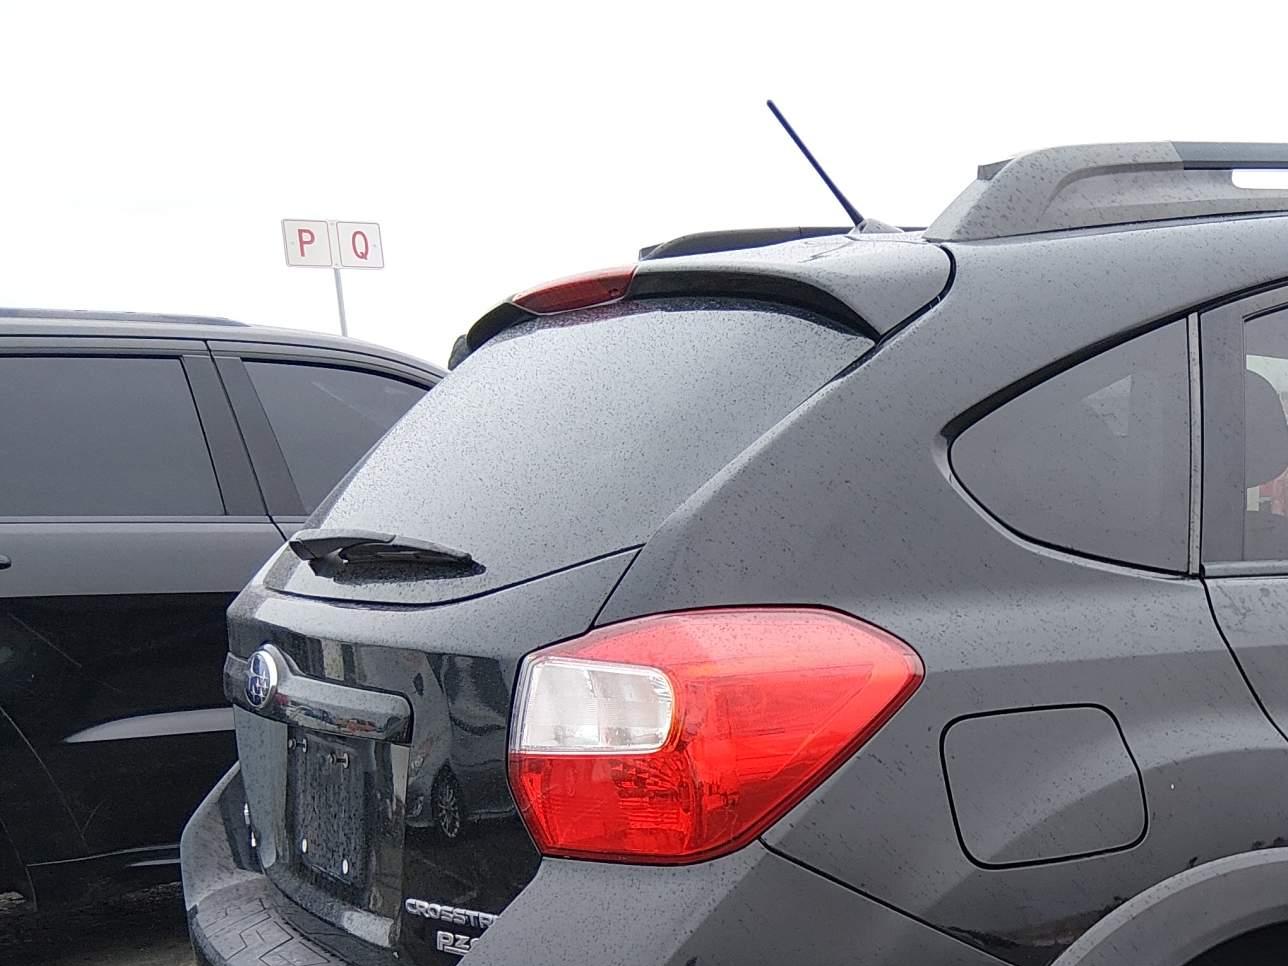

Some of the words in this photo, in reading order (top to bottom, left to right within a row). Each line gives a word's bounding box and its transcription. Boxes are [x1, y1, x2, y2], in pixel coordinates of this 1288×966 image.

[297, 228, 315, 257] P
[351, 230, 369, 260] Q
[405, 898, 499, 929] CROSSTR
[436, 930, 480, 953] PZ
